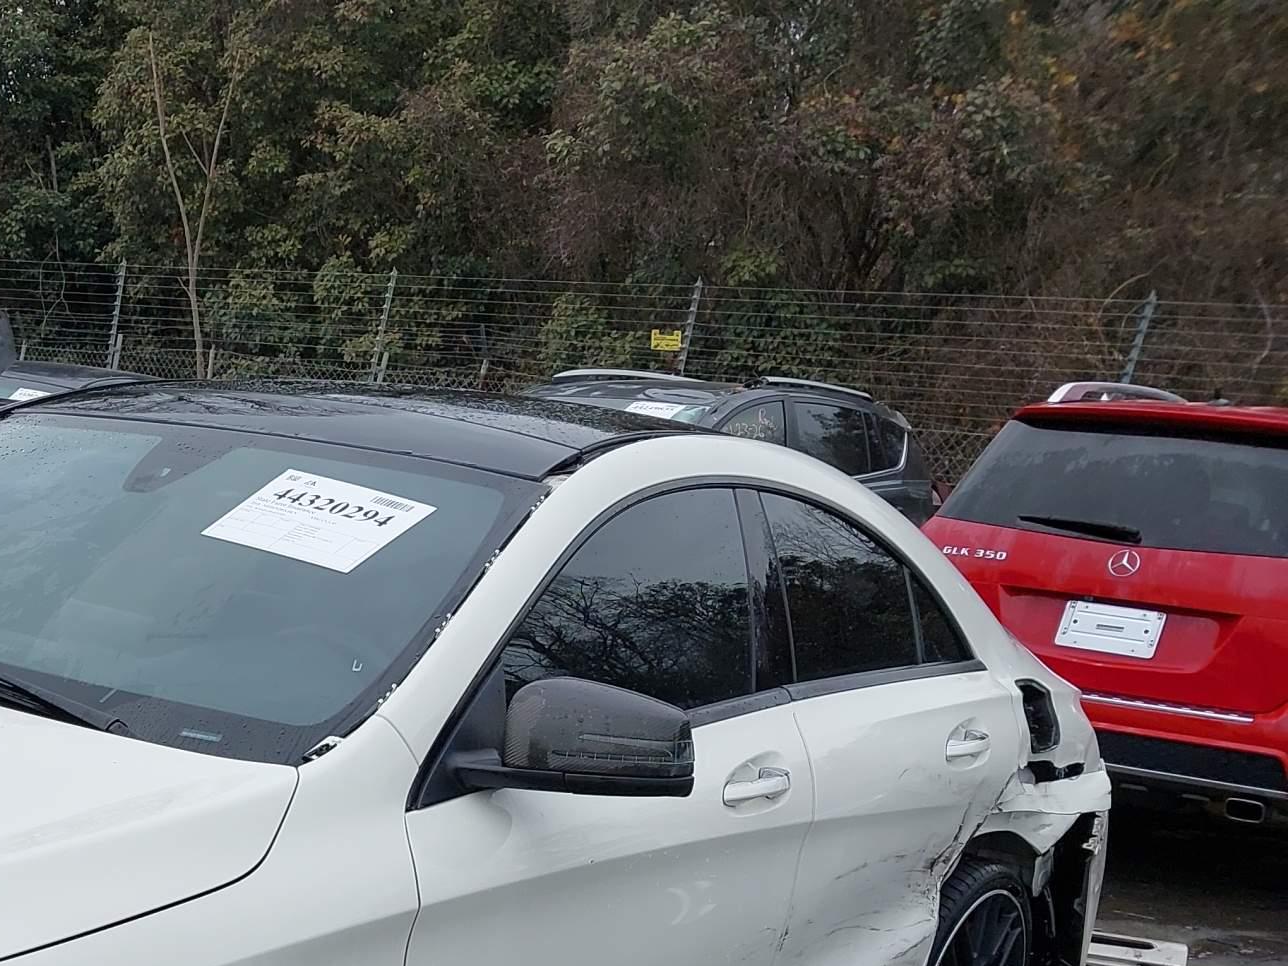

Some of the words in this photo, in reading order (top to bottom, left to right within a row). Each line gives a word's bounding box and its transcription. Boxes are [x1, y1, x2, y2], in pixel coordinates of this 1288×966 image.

[273, 488, 396, 527] 44320294
[942, 545, 970, 557] GLK
[974, 548, 1008, 561] 350
